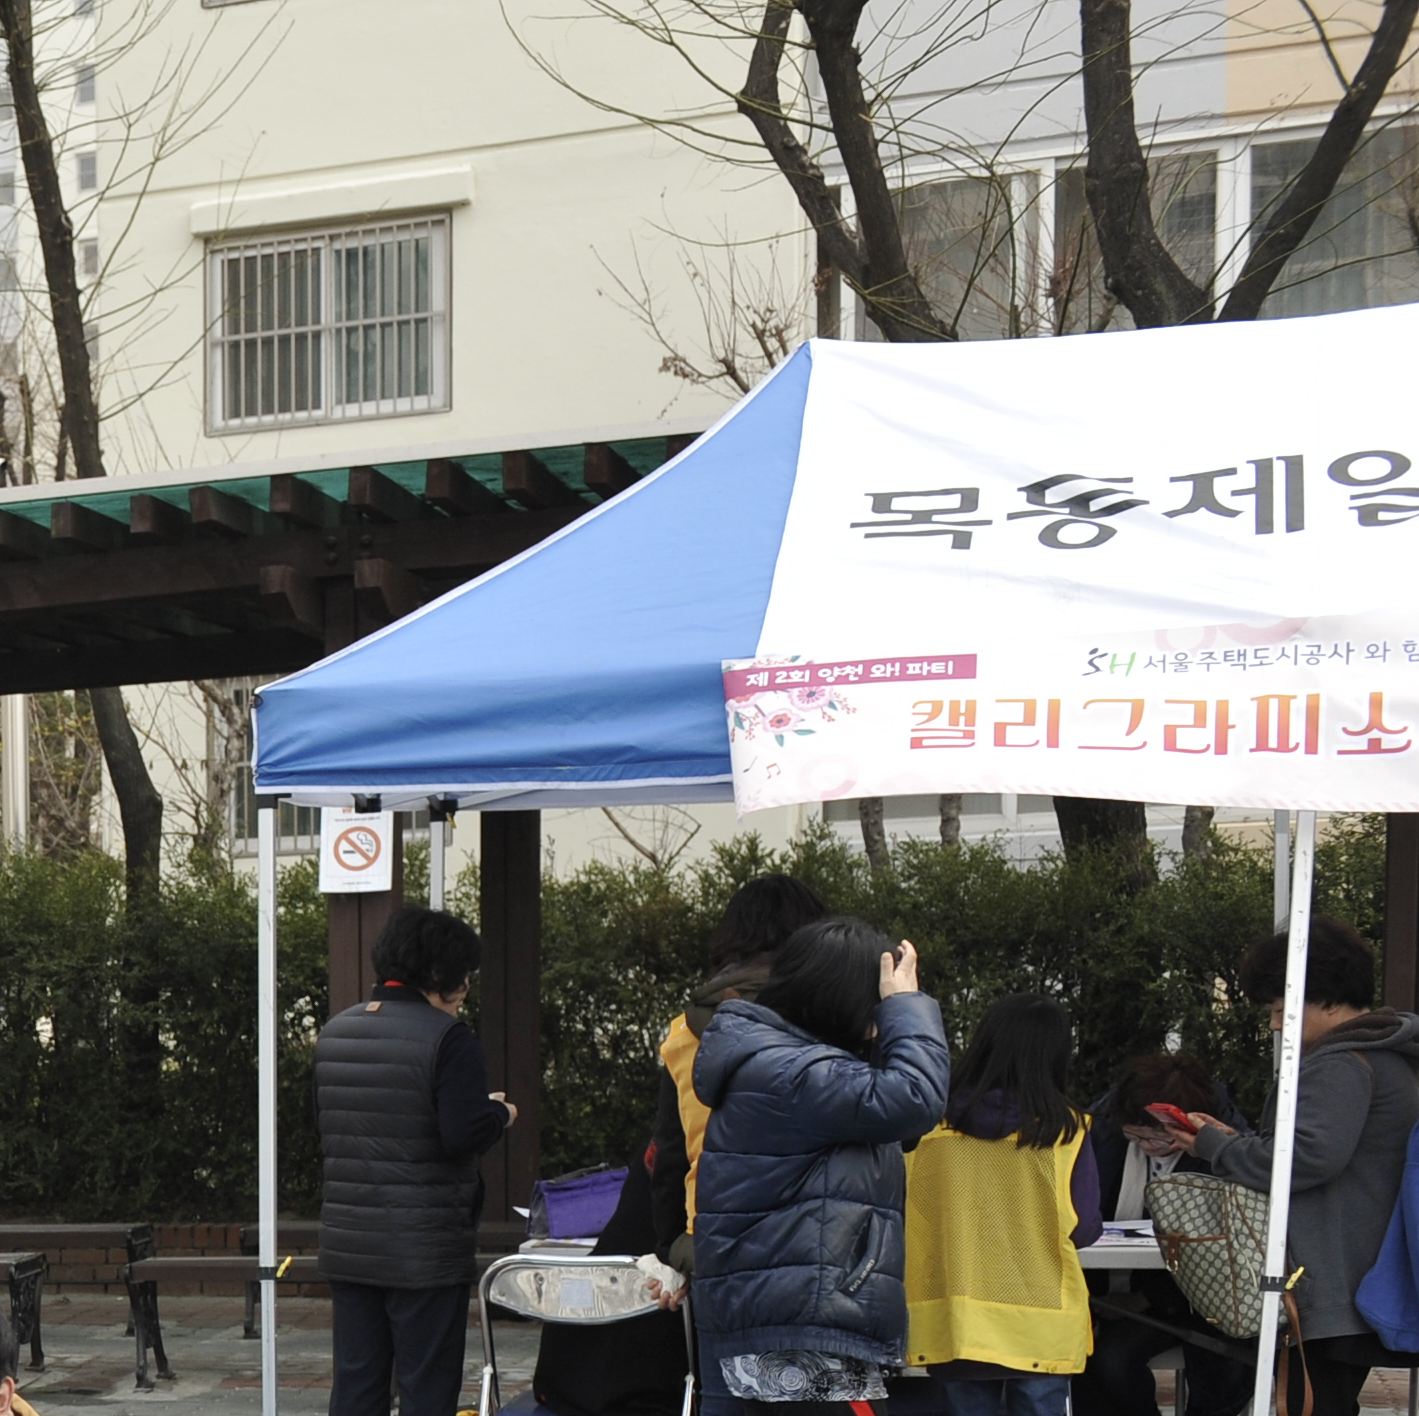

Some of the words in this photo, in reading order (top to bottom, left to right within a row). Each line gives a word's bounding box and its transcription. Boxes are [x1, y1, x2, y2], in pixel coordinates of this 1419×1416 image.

[1143, 641, 1355, 674] 서울주택도시공사
[1364, 640, 1392, 663] 와
[745, 672, 769, 687] 제
[774, 670, 810, 684] 2회
[817, 664, 863, 683] 양천
[869, 661, 900, 678] 와!
[906, 660, 954, 676] 파티
